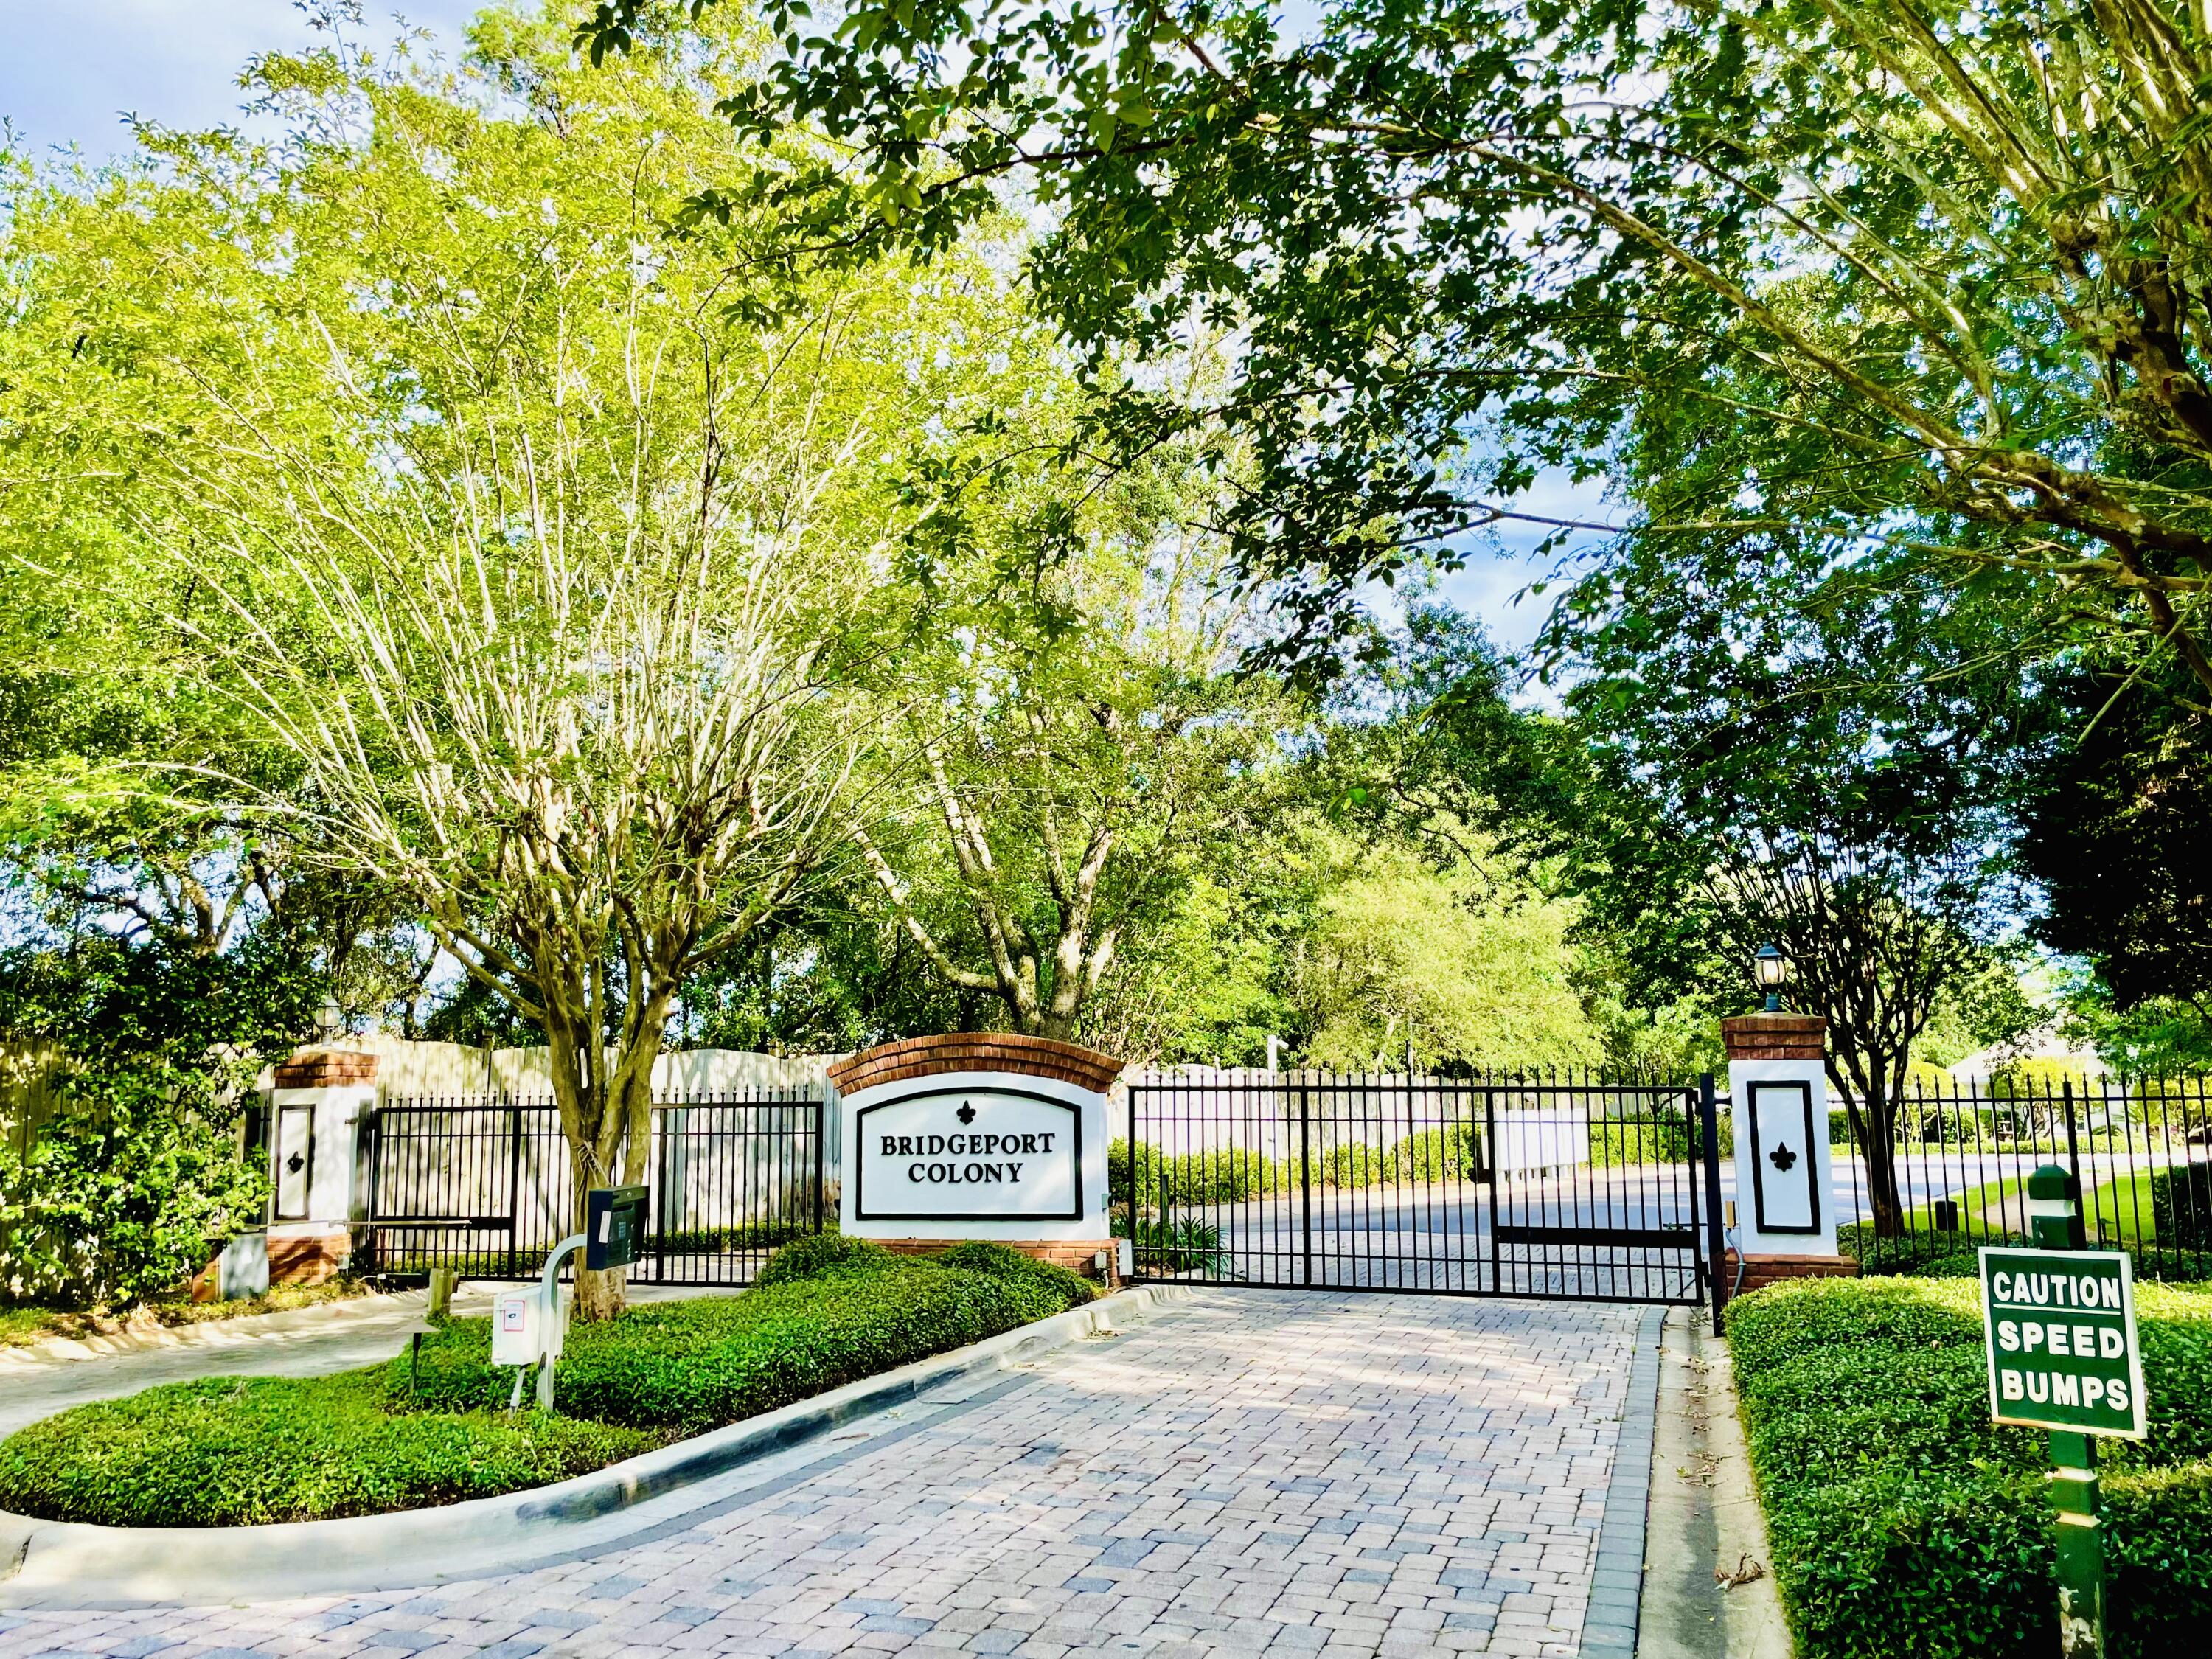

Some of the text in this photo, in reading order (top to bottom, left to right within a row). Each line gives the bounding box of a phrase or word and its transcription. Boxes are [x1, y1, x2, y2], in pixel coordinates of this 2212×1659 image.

[880, 1133, 1056, 1156] BRIDGEPORT
[908, 1162, 1024, 1184] COLONY
[1993, 1271, 2121, 1309] CAUTION
[1997, 1320, 2124, 1360] SPEED
[2000, 1368, 2129, 1411] BUMPS
